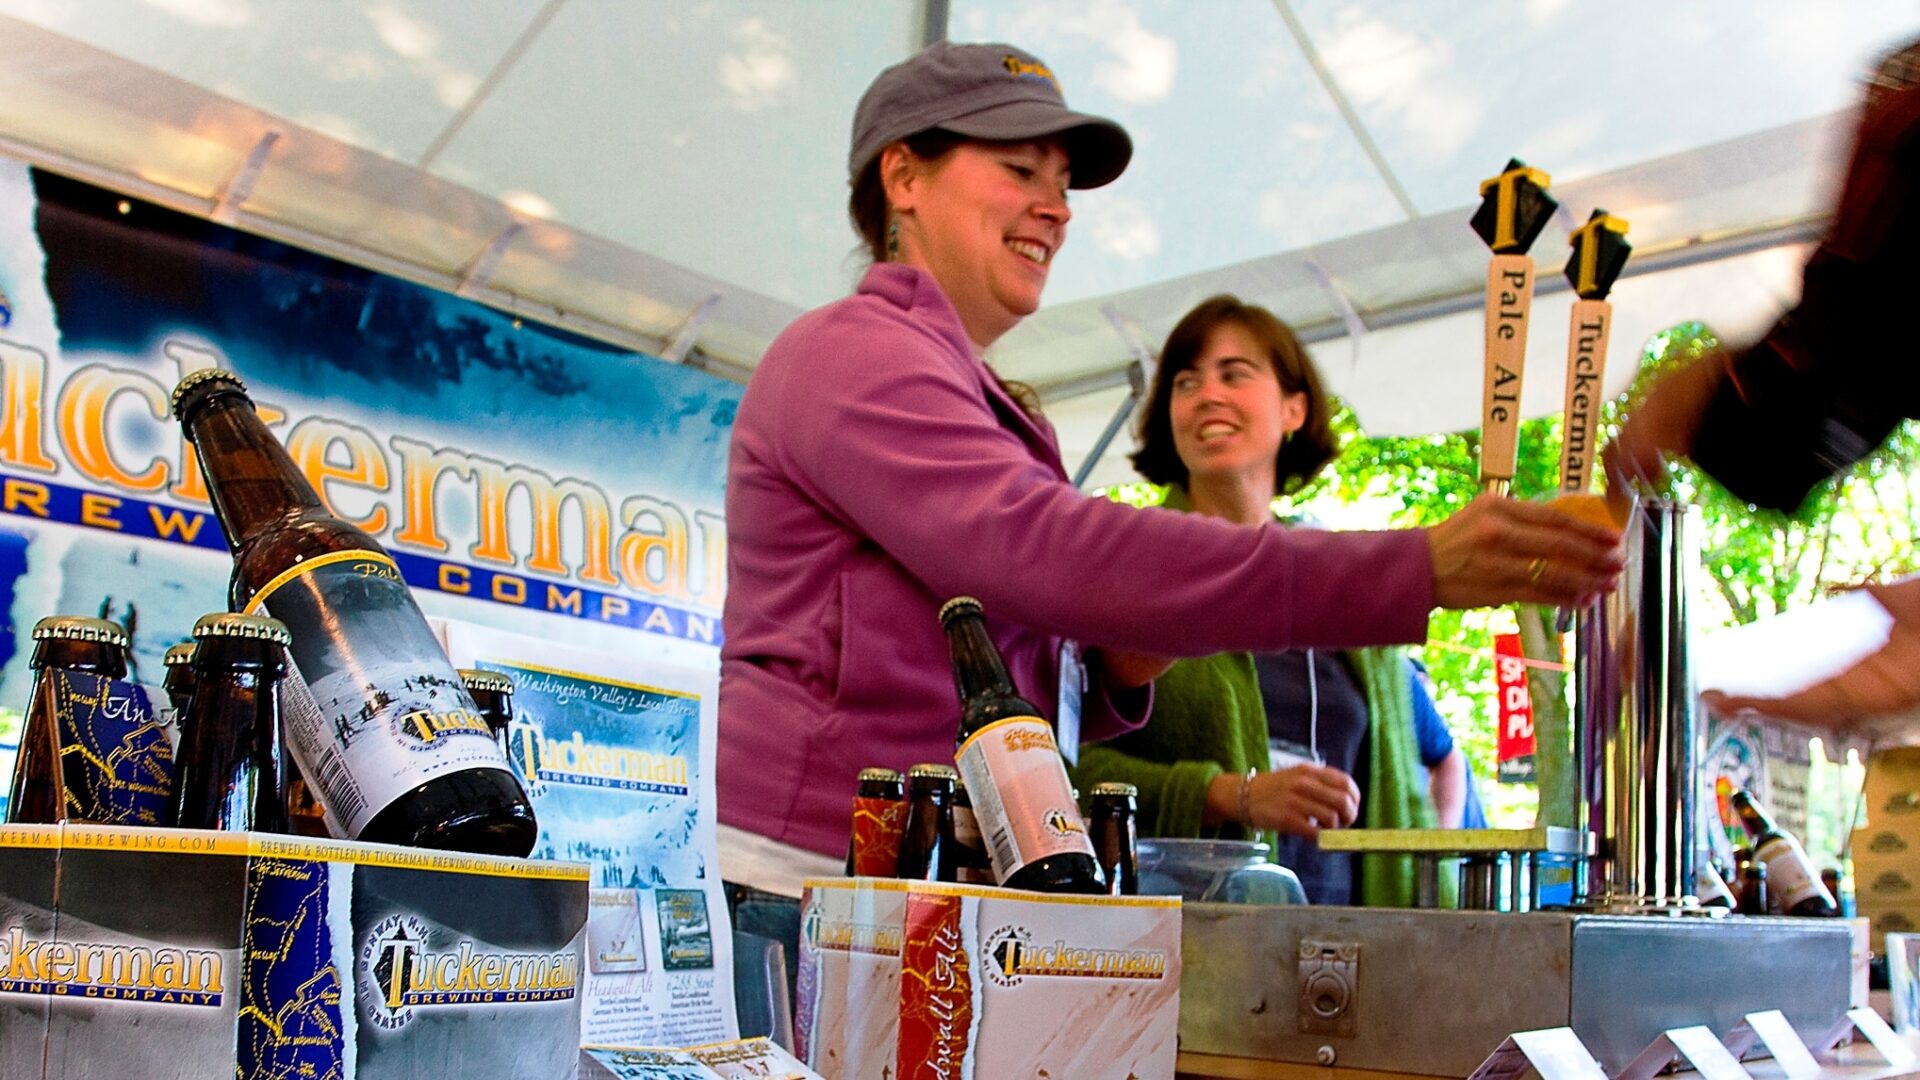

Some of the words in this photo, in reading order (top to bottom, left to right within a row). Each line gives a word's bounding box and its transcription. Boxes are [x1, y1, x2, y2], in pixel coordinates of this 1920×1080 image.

[1497, 270, 1526, 340] Pale
[1491, 363, 1518, 423] Ale
[1565, 315, 1604, 492] Tuckerman
[438, 564, 716, 643] COMPAN
[511, 671, 586, 706] Washington
[590, 684, 635, 712] Valley's
[636, 694, 665, 713] Local
[510, 723, 687, 785] Tuckerman
[541, 770, 611, 787] BREWING
[620, 779, 687, 795] COMPANY
[260, 841, 300, 855] BREWED
[305, 844, 311, 855] &
[315, 845, 356, 860] BOTTLED
[359, 849, 370, 861] BY
[374, 851, 429, 865] TUCKERMAN
[432, 857, 471, 870] BREWING
[494, 862, 507, 873] LLC
[379, 938, 577, 1008] Tuckerman
[935, 926, 959, 991] Alt
[998, 937, 1166, 976] Tuckerman
[85, 986, 214, 1006] COMPANY
[359, 980, 370, 1001] IN
[409, 993, 494, 1005] BREWING
[505, 989, 574, 1002] COMPANY
[366, 1004, 413, 1030] BREWED
